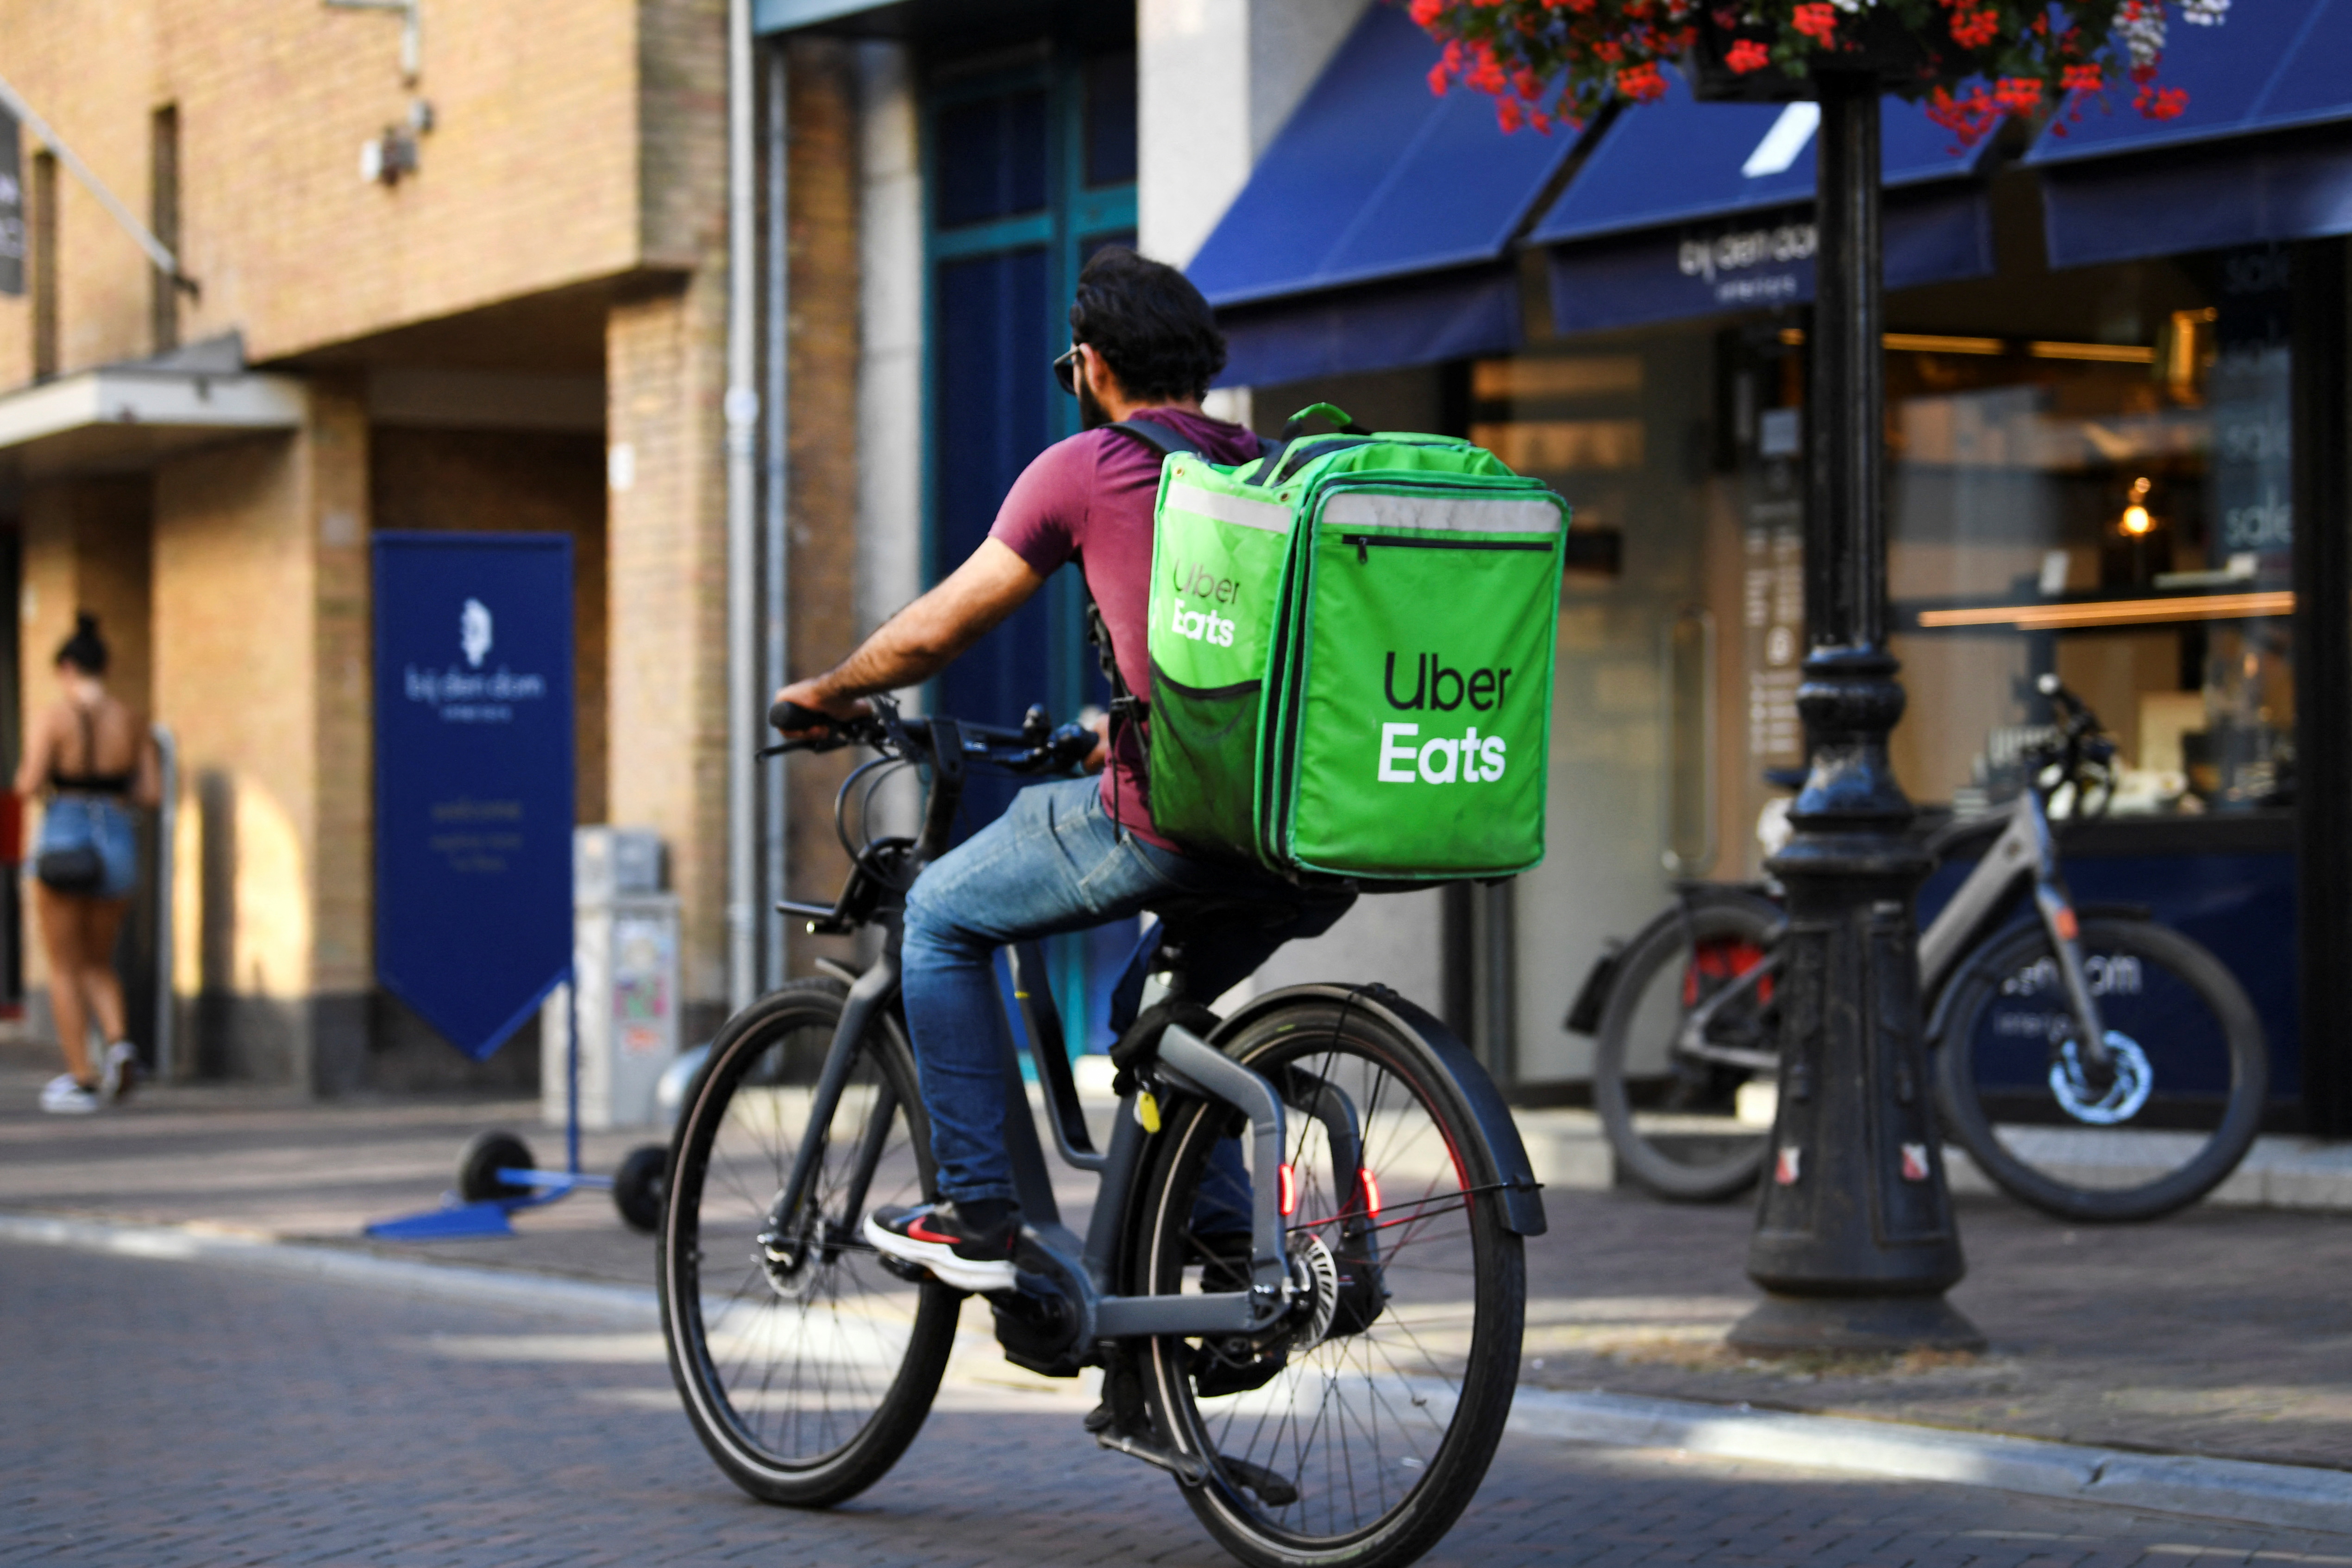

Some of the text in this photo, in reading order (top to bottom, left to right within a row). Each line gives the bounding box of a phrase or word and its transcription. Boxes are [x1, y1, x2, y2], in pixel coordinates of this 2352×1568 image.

[1773, 222, 1818, 262] do
[1173, 557, 1240, 604] Uber
[1171, 596, 1236, 647] Eats
[1383, 651, 1512, 711] Uber
[1377, 721, 1506, 785] Eats
